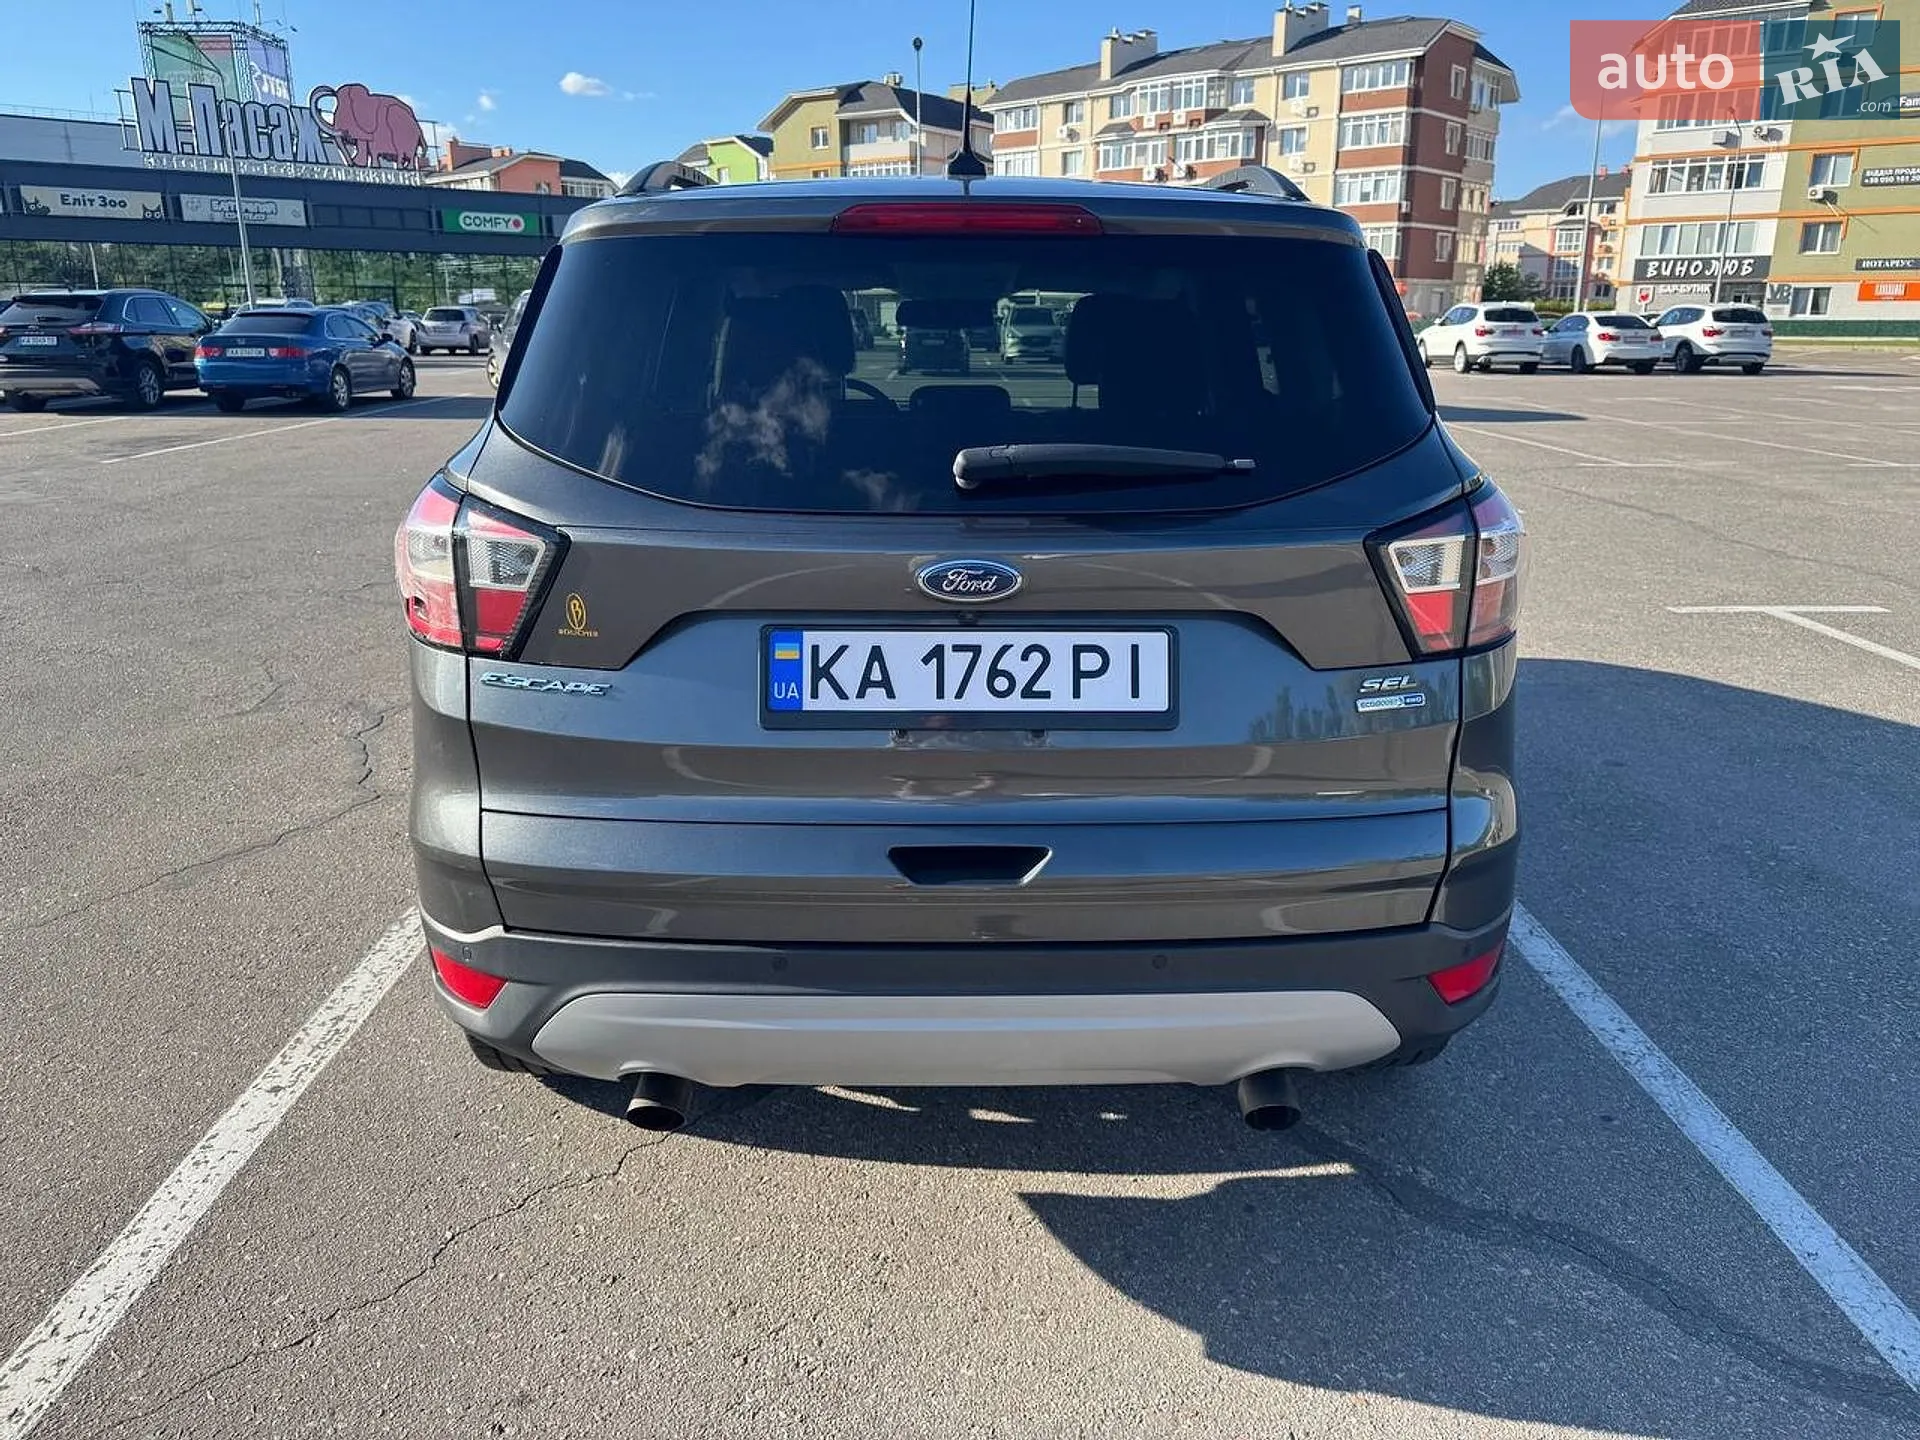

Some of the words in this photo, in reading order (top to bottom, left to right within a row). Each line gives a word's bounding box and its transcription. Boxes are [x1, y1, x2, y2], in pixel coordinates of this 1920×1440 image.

[462, 215, 511, 229] COMFY
[1646, 258, 1754, 278] ВИНОЛЮБ
[942, 568, 998, 591] Ford
[809, 643, 897, 700] KA
[920, 643, 1052, 700] 1762
[480, 672, 614, 696] ESCAPE
[773, 681, 800, 699] UA
[1359, 674, 1417, 693] SEL
